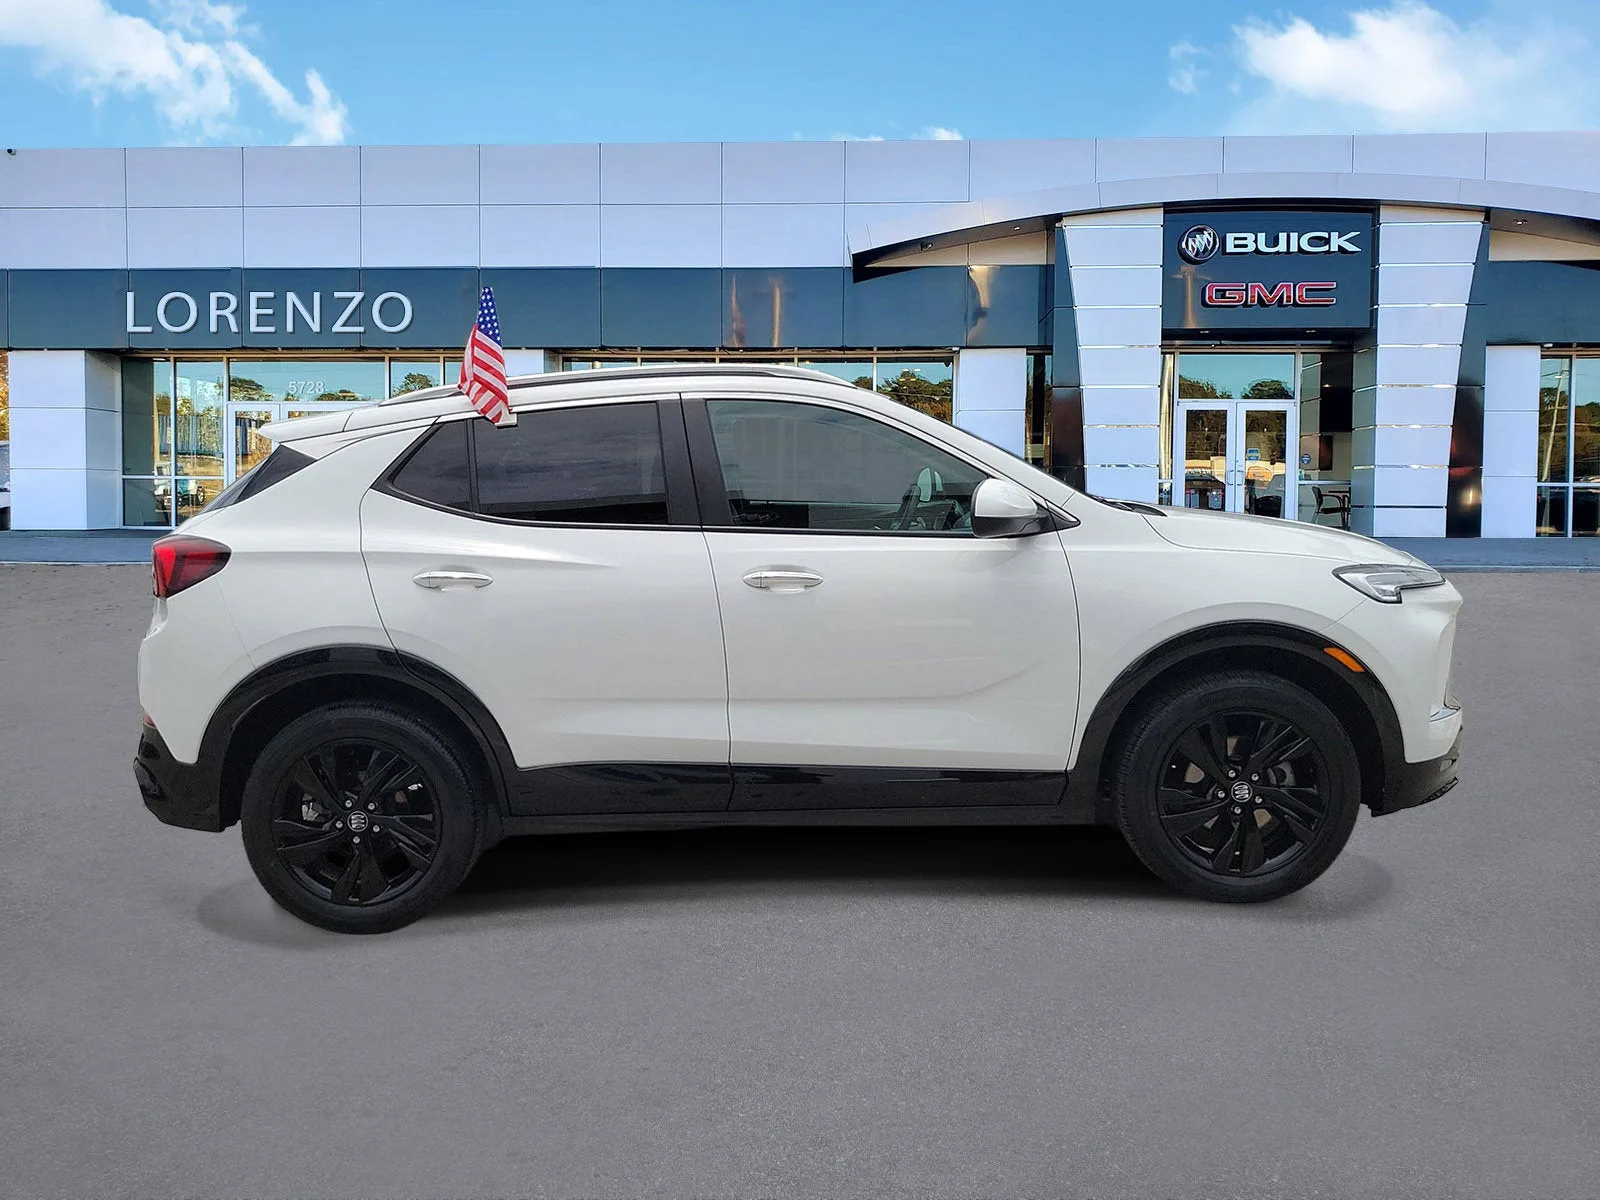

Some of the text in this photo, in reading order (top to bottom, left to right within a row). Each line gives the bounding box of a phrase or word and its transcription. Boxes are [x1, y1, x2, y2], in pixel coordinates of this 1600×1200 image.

[1225, 231, 1362, 253] BUICK
[1204, 281, 1337, 306] GMC
[126, 291, 413, 334] LORENZO
[288, 380, 325, 395] 5728
